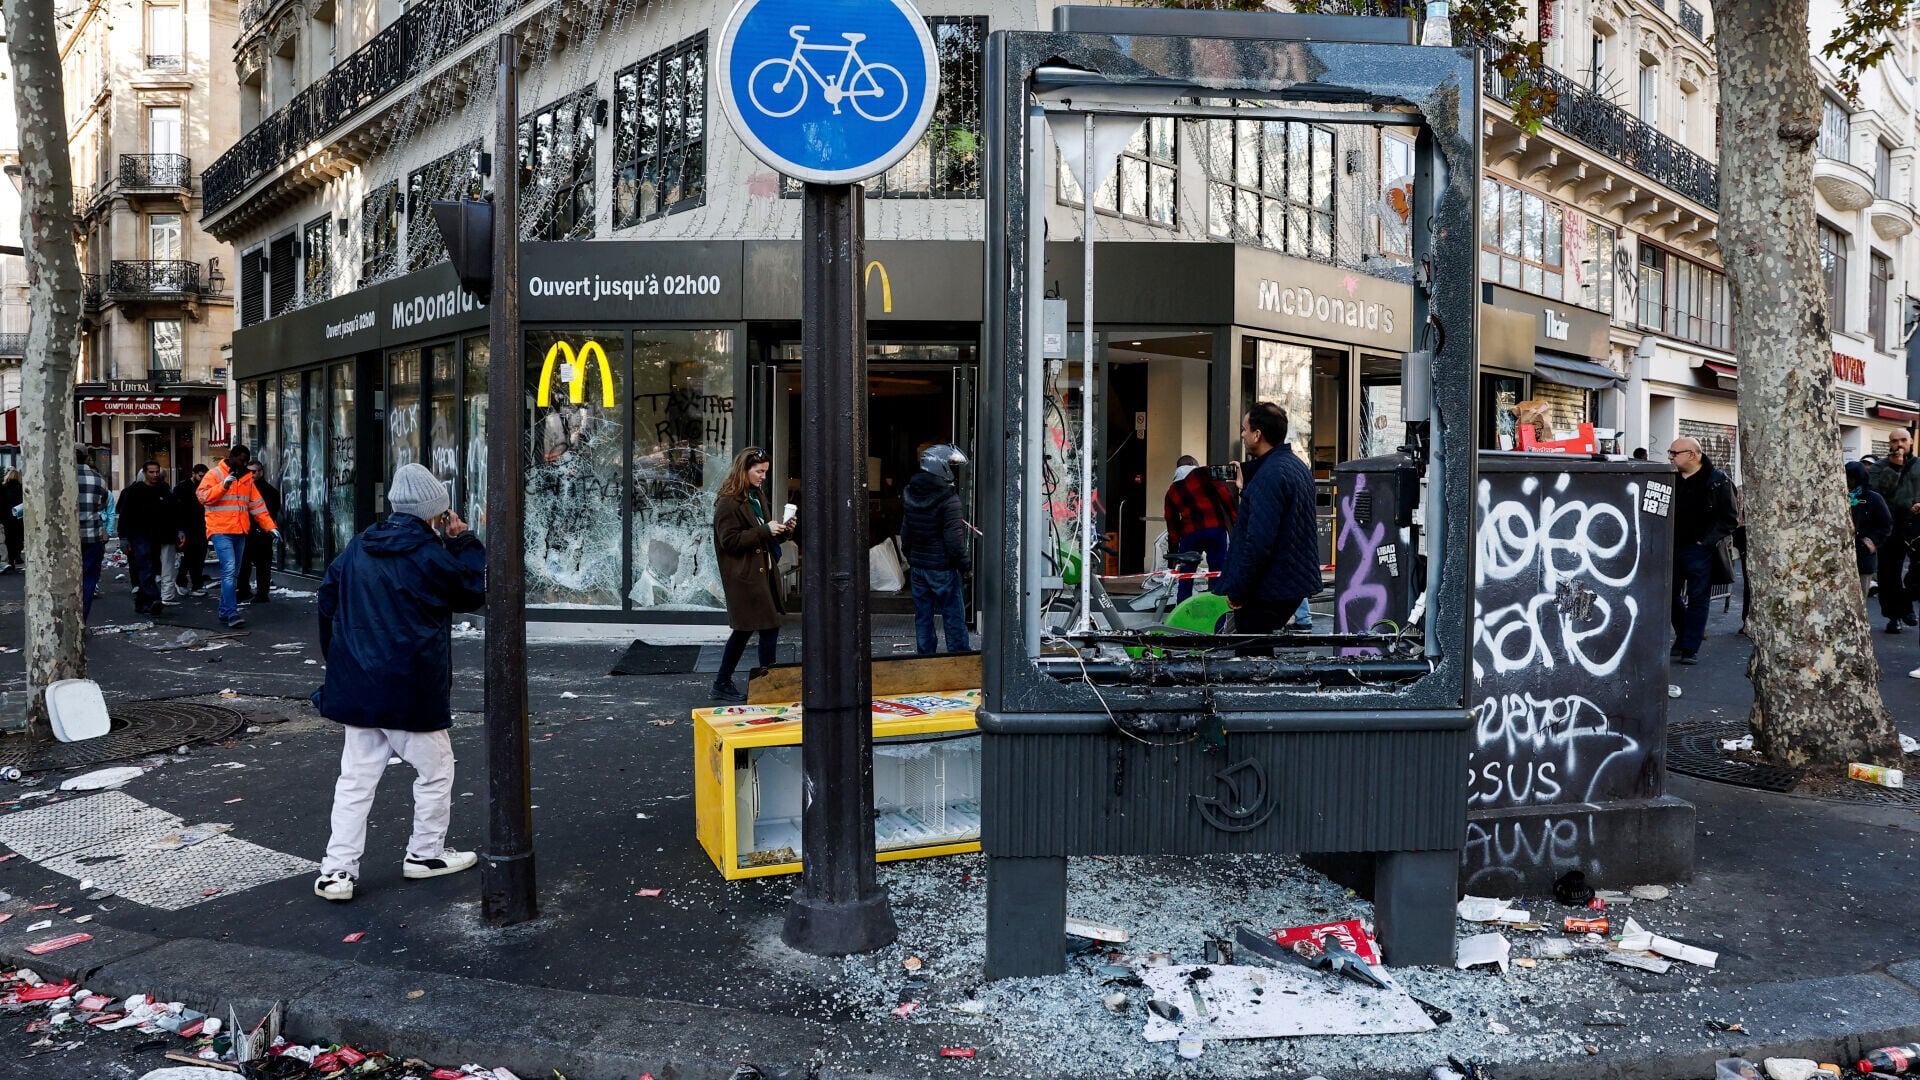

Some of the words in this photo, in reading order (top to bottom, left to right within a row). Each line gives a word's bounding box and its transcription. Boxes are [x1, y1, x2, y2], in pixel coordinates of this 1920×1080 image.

[529, 276, 591, 297] Ouvert
[592, 274, 659, 302] jusqu'à
[663, 274, 721, 296] 02h00
[391, 285, 486, 330] McDonald
[1257, 278, 1394, 335] McDonald's
[326, 321, 342, 339] Ouvert
[359, 310, 376, 330] 02h00
[104, 402, 134, 411] COMPTOIR
[134, 402, 161, 411] PARISIEN
[696, 394, 735, 413] THE
[1642, 498, 1659, 514] 18
[1644, 489, 1671, 505] APPLES
